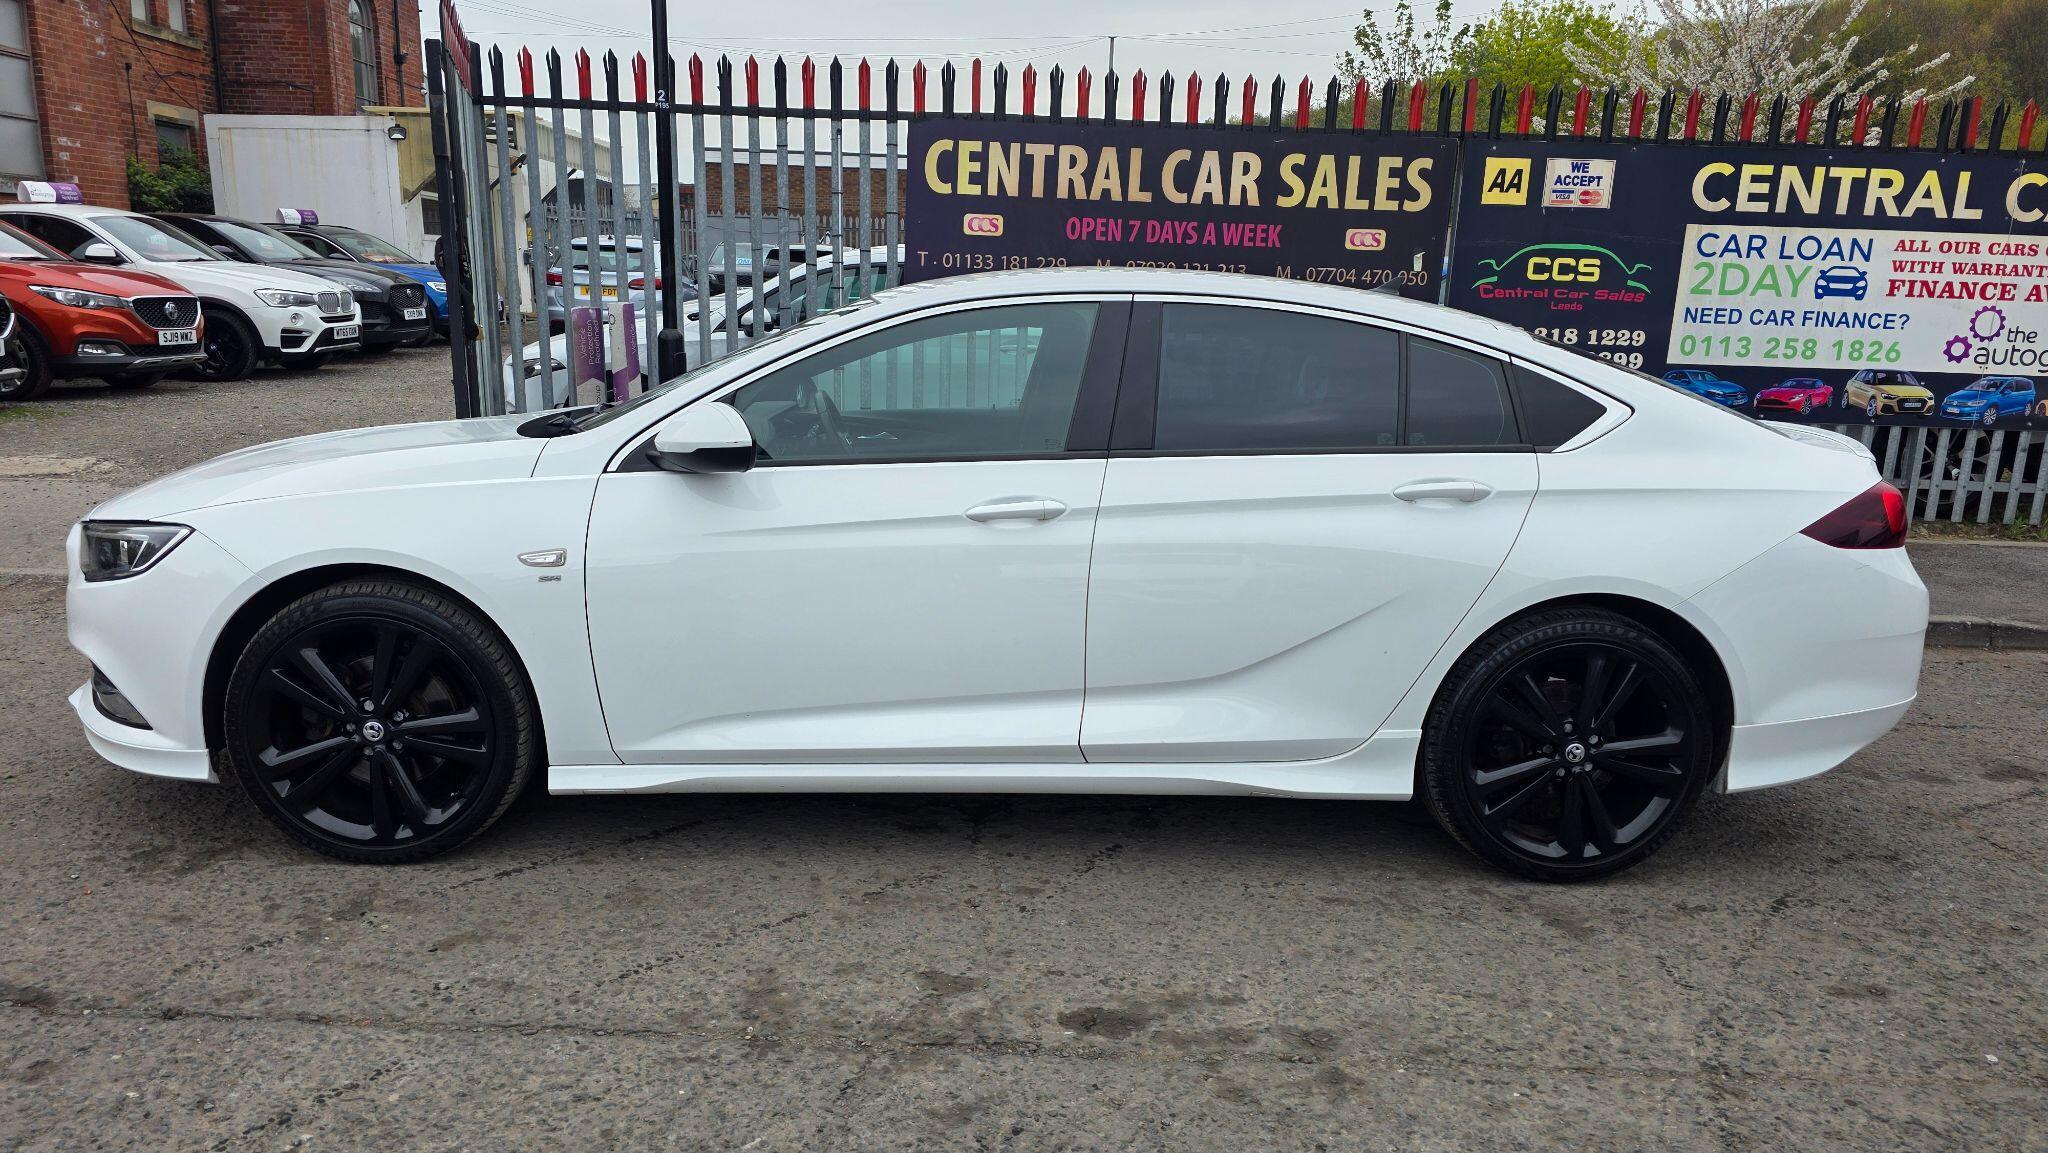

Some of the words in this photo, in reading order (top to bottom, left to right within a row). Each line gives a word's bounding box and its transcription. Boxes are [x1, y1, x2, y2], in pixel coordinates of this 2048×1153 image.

[657, 89, 666, 101] 2
[924, 138, 1153, 203] CENTRAL
[1161, 149, 1260, 207] CAR
[1276, 153, 1434, 212] SALES
[1571, 161, 1590, 173] WE
[1487, 168, 1524, 193] AA
[1554, 174, 1603, 187] ACCEPT
[1691, 162, 1983, 220] CENTRAL
[2005, 172, 2048, 223] C
[967, 216, 1000, 233] CCS
[1066, 216, 1122, 242] OPEN
[1128, 220, 1142, 243] 7
[1146, 220, 1199, 245] DAYS
[1202, 222, 1217, 246] A
[1222, 222, 1283, 248] WEEK
[1349, 231, 1382, 248] CCS
[1696, 232, 1768, 259] CAR
[1778, 235, 1874, 263] LOAN
[1894, 239, 1931, 253] ALL
[1938, 240, 1981, 255] OUR
[1988, 242, 2040, 257] CARS
[917, 251, 929, 267] T
[942, 252, 994, 270] 01133
[1001, 255, 1028, 270] 181
[1036, 257, 1067, 268] 229
[1526, 256, 1601, 282] CCS
[1892, 260, 1945, 274] WITH
[1951, 261, 2048, 278] WARRANT
[1276, 265, 1291, 279] M
[1306, 266, 1356, 283] 07704
[1361, 268, 1392, 284] 470
[1398, 270, 1428, 286] 950
[1689, 261, 1813, 298] 2DAY
[1479, 283, 1549, 299] Central
[1554, 288, 1589, 300] Car
[1593, 289, 1646, 303] Sales
[1886, 279, 2018, 301] FINANCE
[2024, 284, 2048, 302] A
[1550, 301, 1583, 311] Leeds
[1683, 306, 1743, 325] NEED
[1749, 309, 1795, 327] CAR
[1801, 310, 1910, 331] FINANCE?
[162, 332, 179, 343] SJ19
[1587, 329, 1646, 347] 1229
[2006, 326, 2038, 344] the
[1679, 334, 1752, 359] 0113
[1763, 337, 1817, 360] 258
[1831, 339, 1902, 364] 1826
